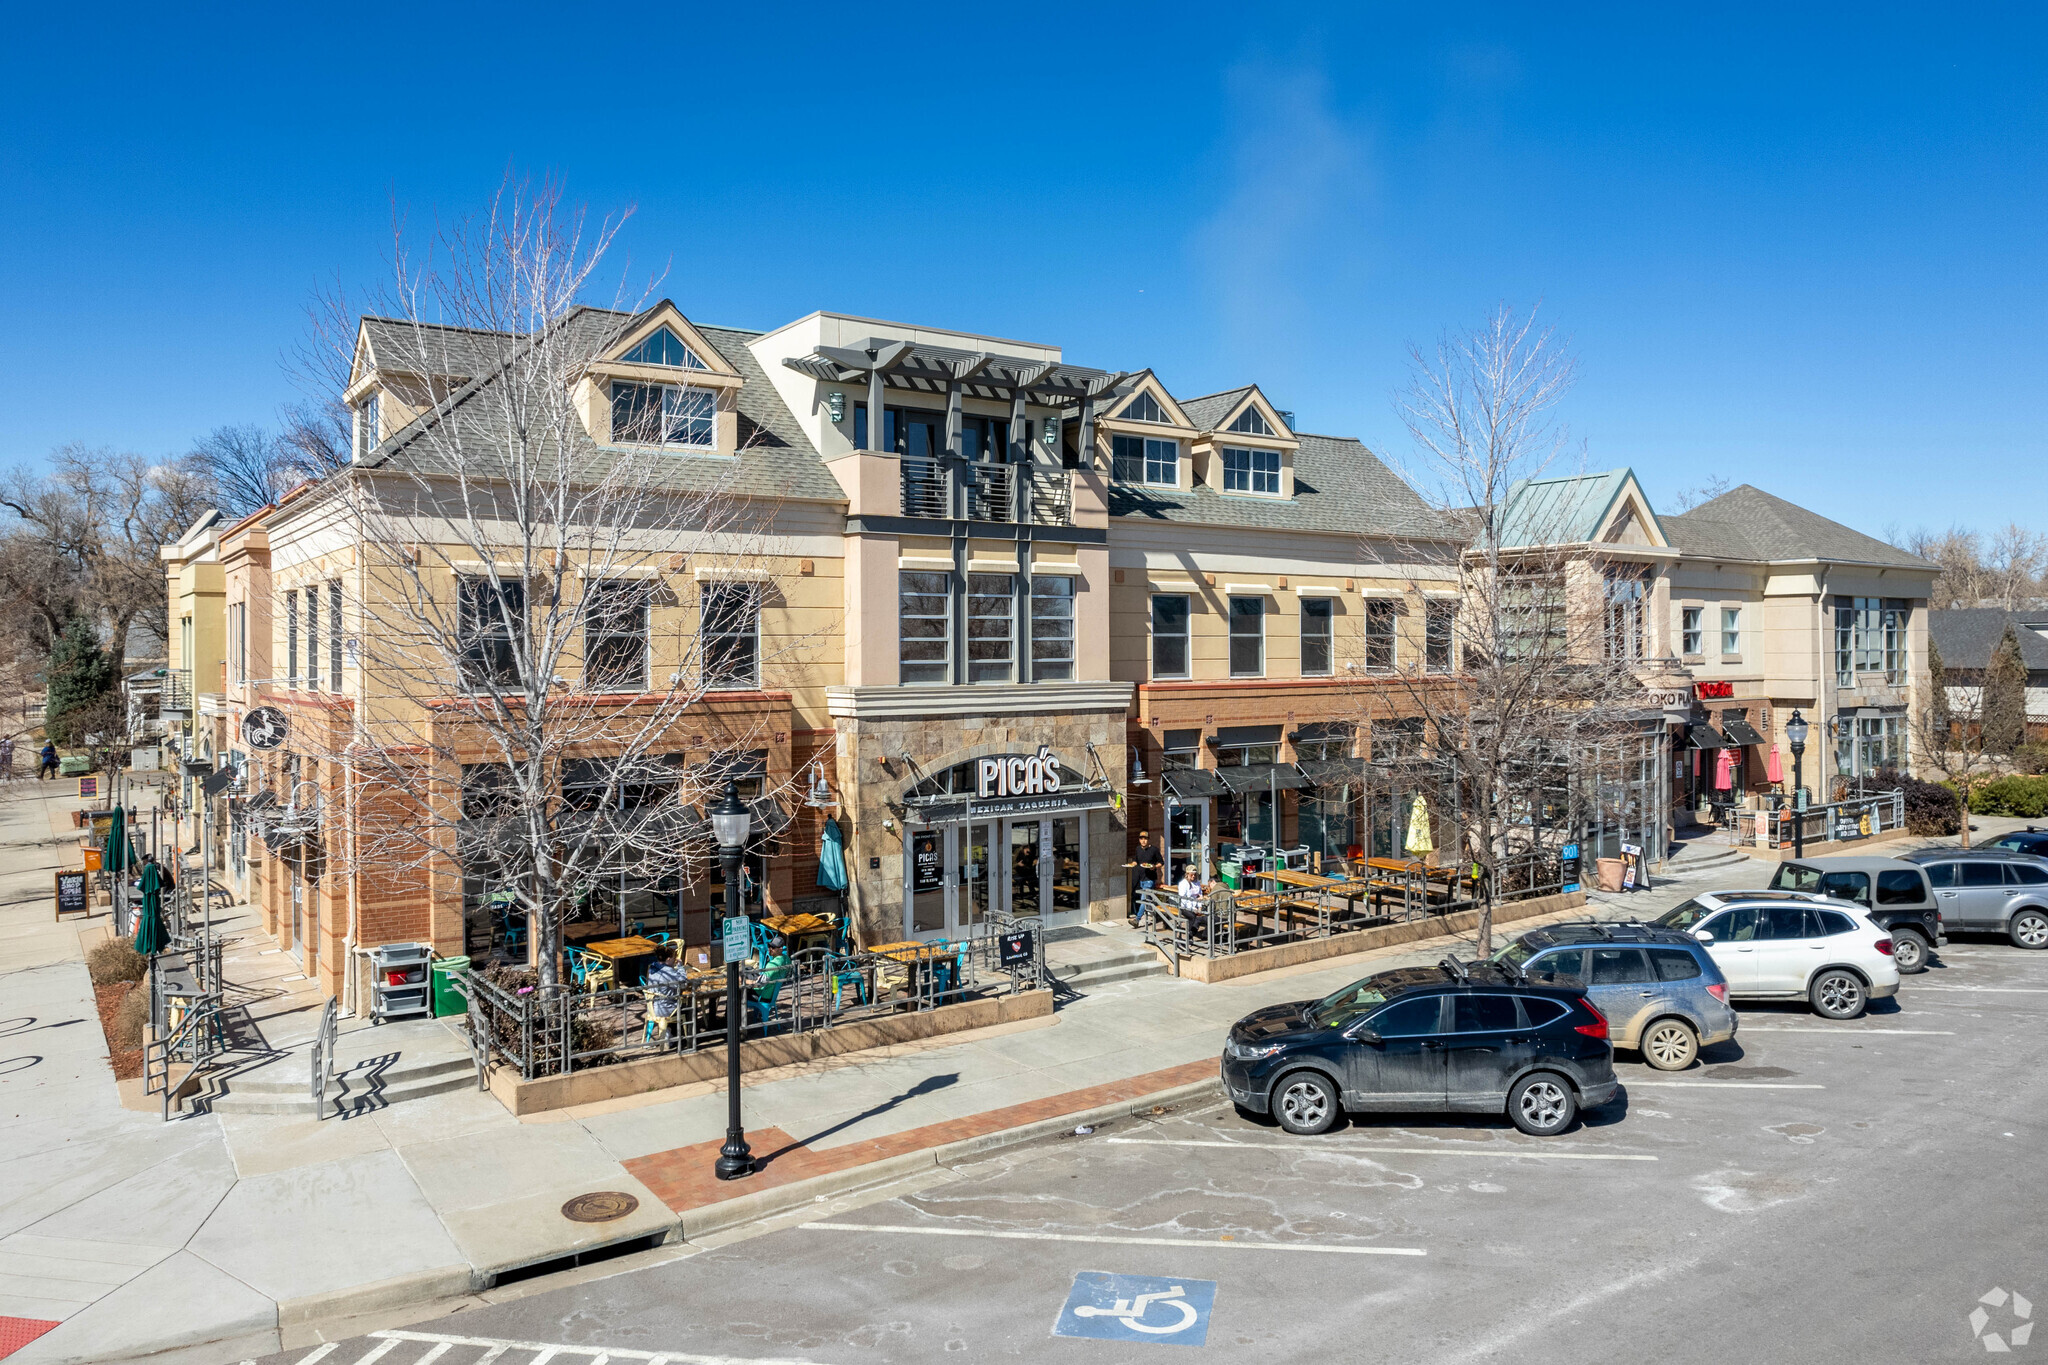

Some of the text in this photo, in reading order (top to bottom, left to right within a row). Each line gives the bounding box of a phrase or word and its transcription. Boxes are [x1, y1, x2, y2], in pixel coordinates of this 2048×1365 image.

[1649, 693, 1676, 706] OKO
[970, 799, 1068, 814] MEXICAN TAQUERIA
[1563, 846, 1577, 858] 901
[61, 882, 80, 890] SHOP
[63, 887, 82, 895] OPEN
[725, 921, 731, 933] 2
